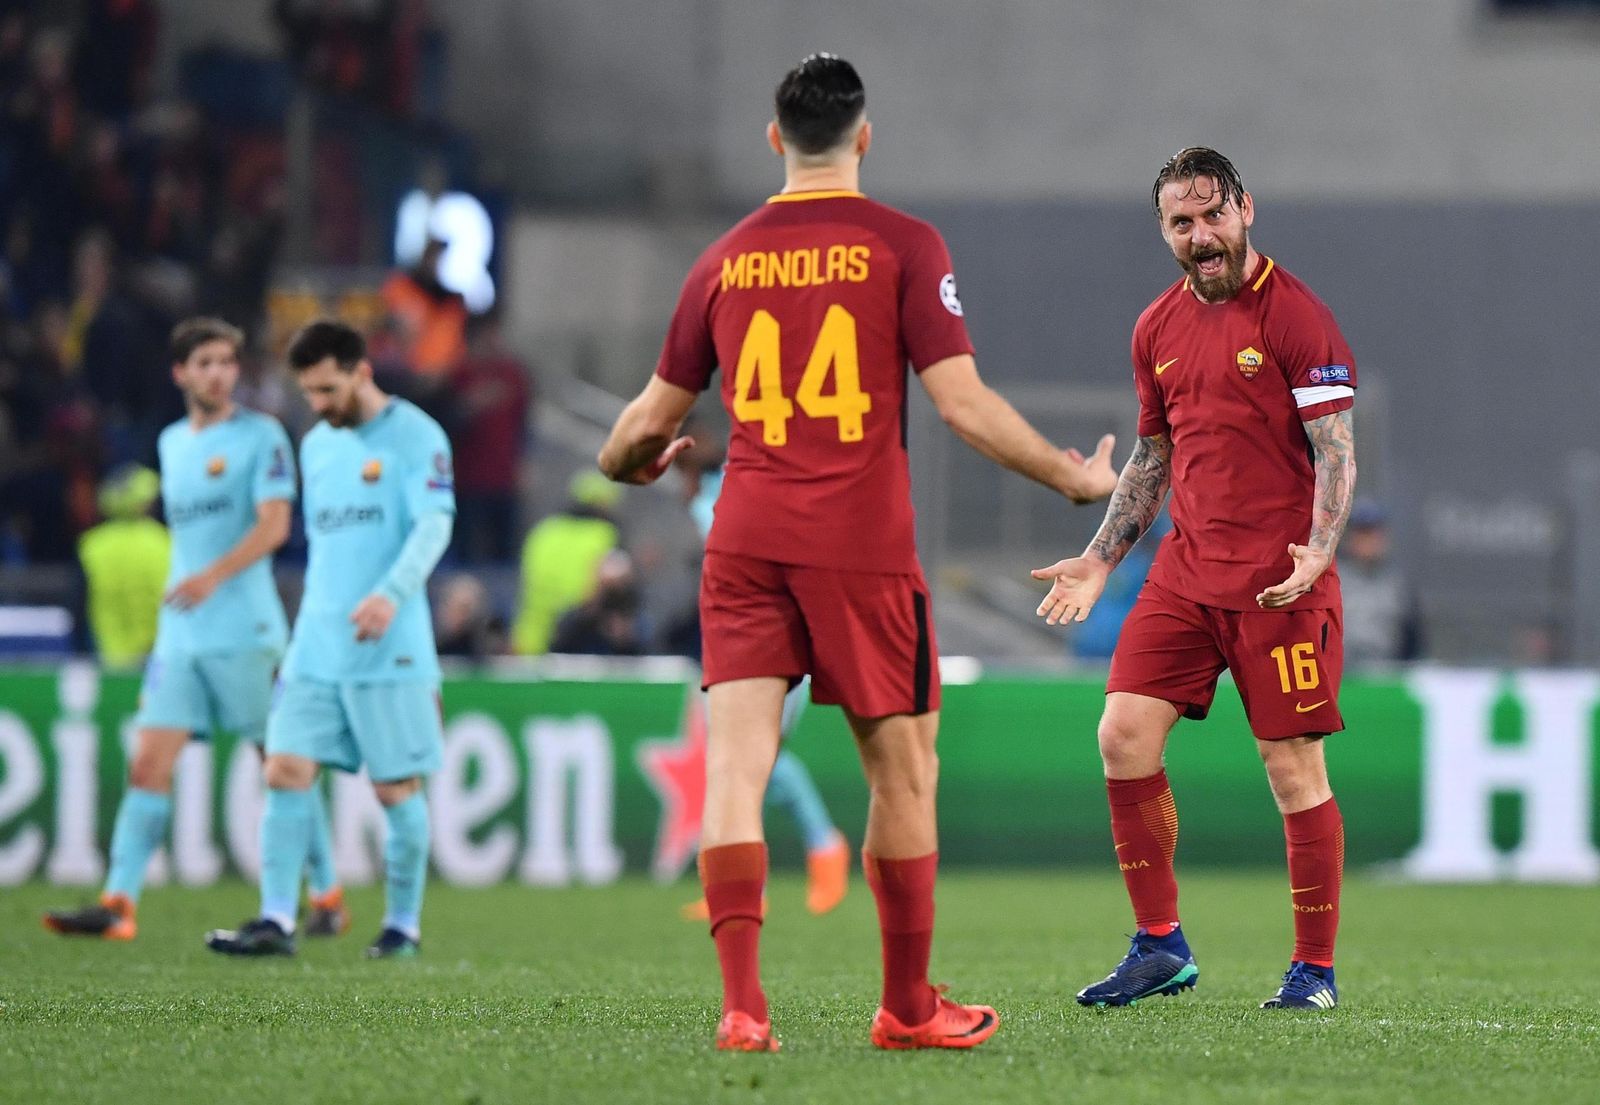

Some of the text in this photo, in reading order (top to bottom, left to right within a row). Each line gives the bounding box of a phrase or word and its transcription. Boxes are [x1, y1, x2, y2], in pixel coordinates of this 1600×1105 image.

[721, 245, 870, 292] MANOLAS
[733, 304, 872, 446] 44
[1321, 368, 1349, 378] RESPECT
[1270, 642, 1320, 694] 16
[1292, 903, 1334, 913] ROMA
